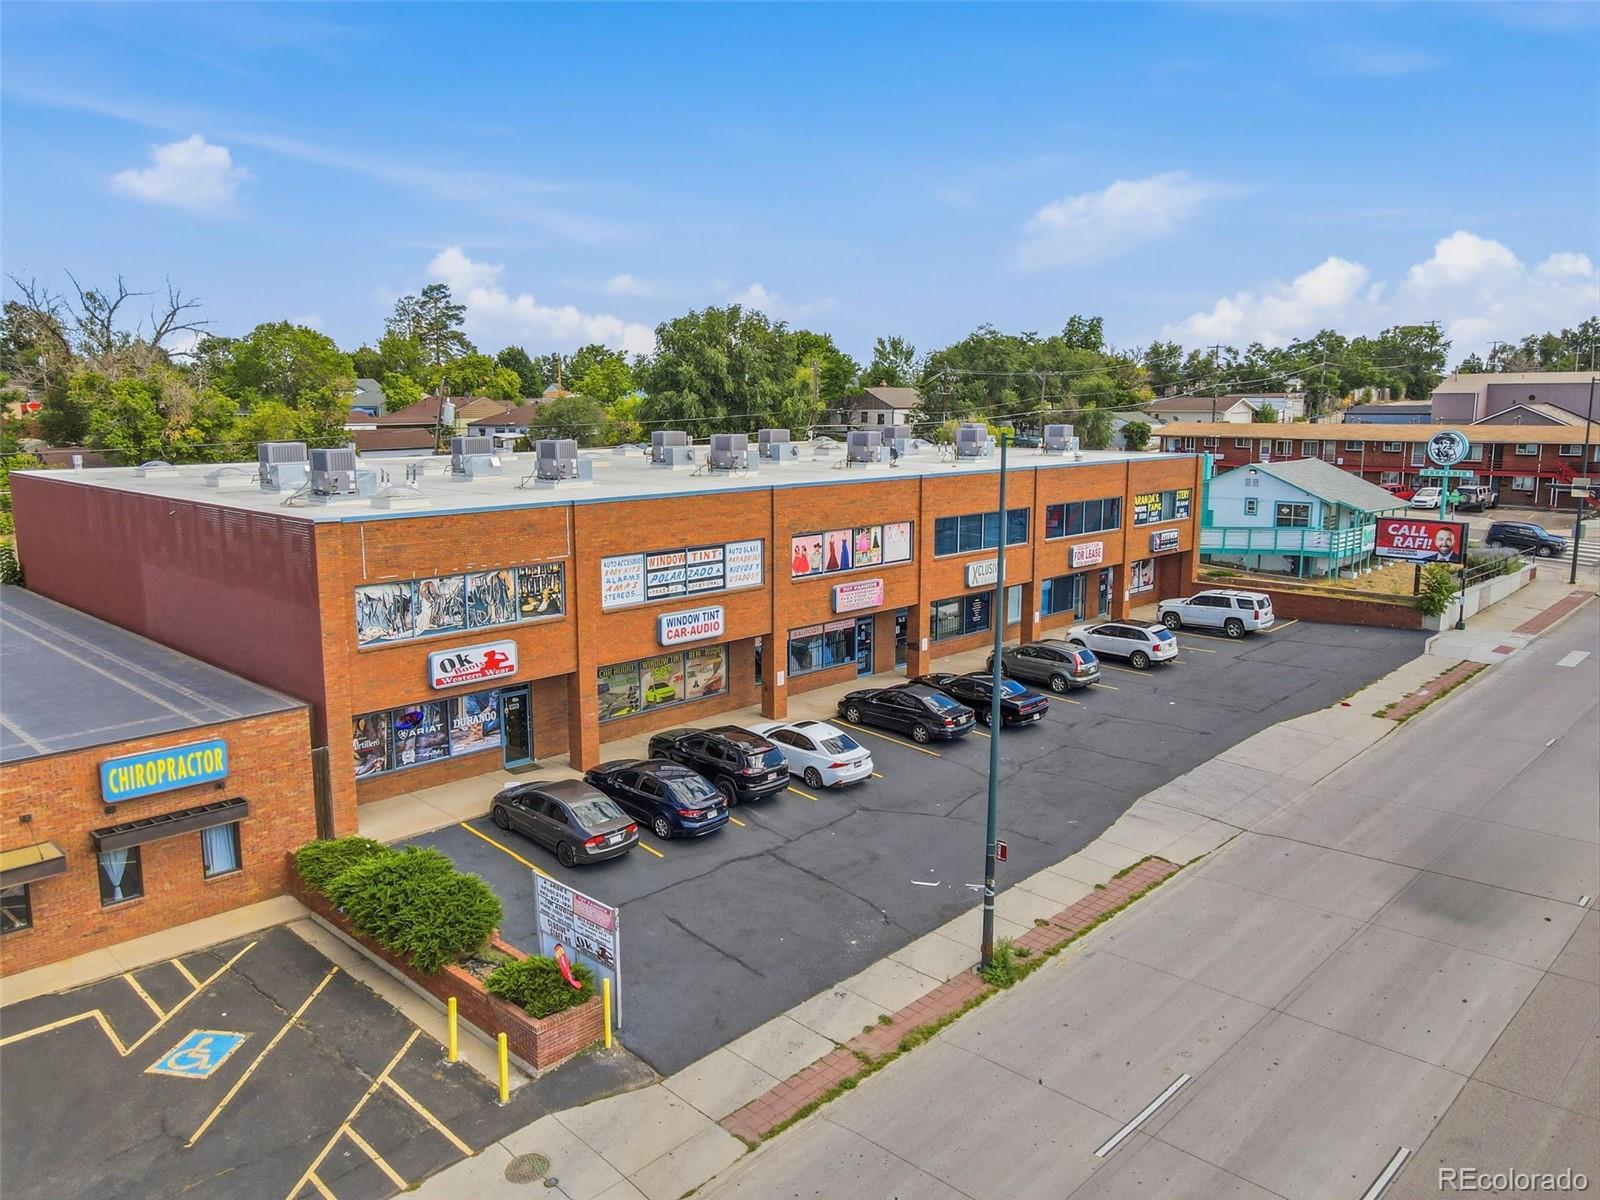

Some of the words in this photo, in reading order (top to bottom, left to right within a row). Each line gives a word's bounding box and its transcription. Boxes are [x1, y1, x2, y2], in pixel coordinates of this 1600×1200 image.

[1387, 523, 1428, 537] CALL
[1393, 536, 1432, 549] RAFI!
[649, 553, 685, 568] WINDOW
[691, 550, 718, 561] TINT
[1074, 550, 1084, 561] FOR
[1086, 547, 1101, 559] LEASE
[972, 563, 998, 585] XCLUSI
[666, 613, 700, 628] WINDOW
[702, 610, 720, 621] TINT
[442, 671, 482, 684] Western
[484, 666, 510, 676] Wear
[455, 661, 486, 675] Boots
[453, 711, 496, 730] DURANGO
[409, 723, 444, 737] ARIAT
[109, 748, 223, 793] CHIROPRACTOR
